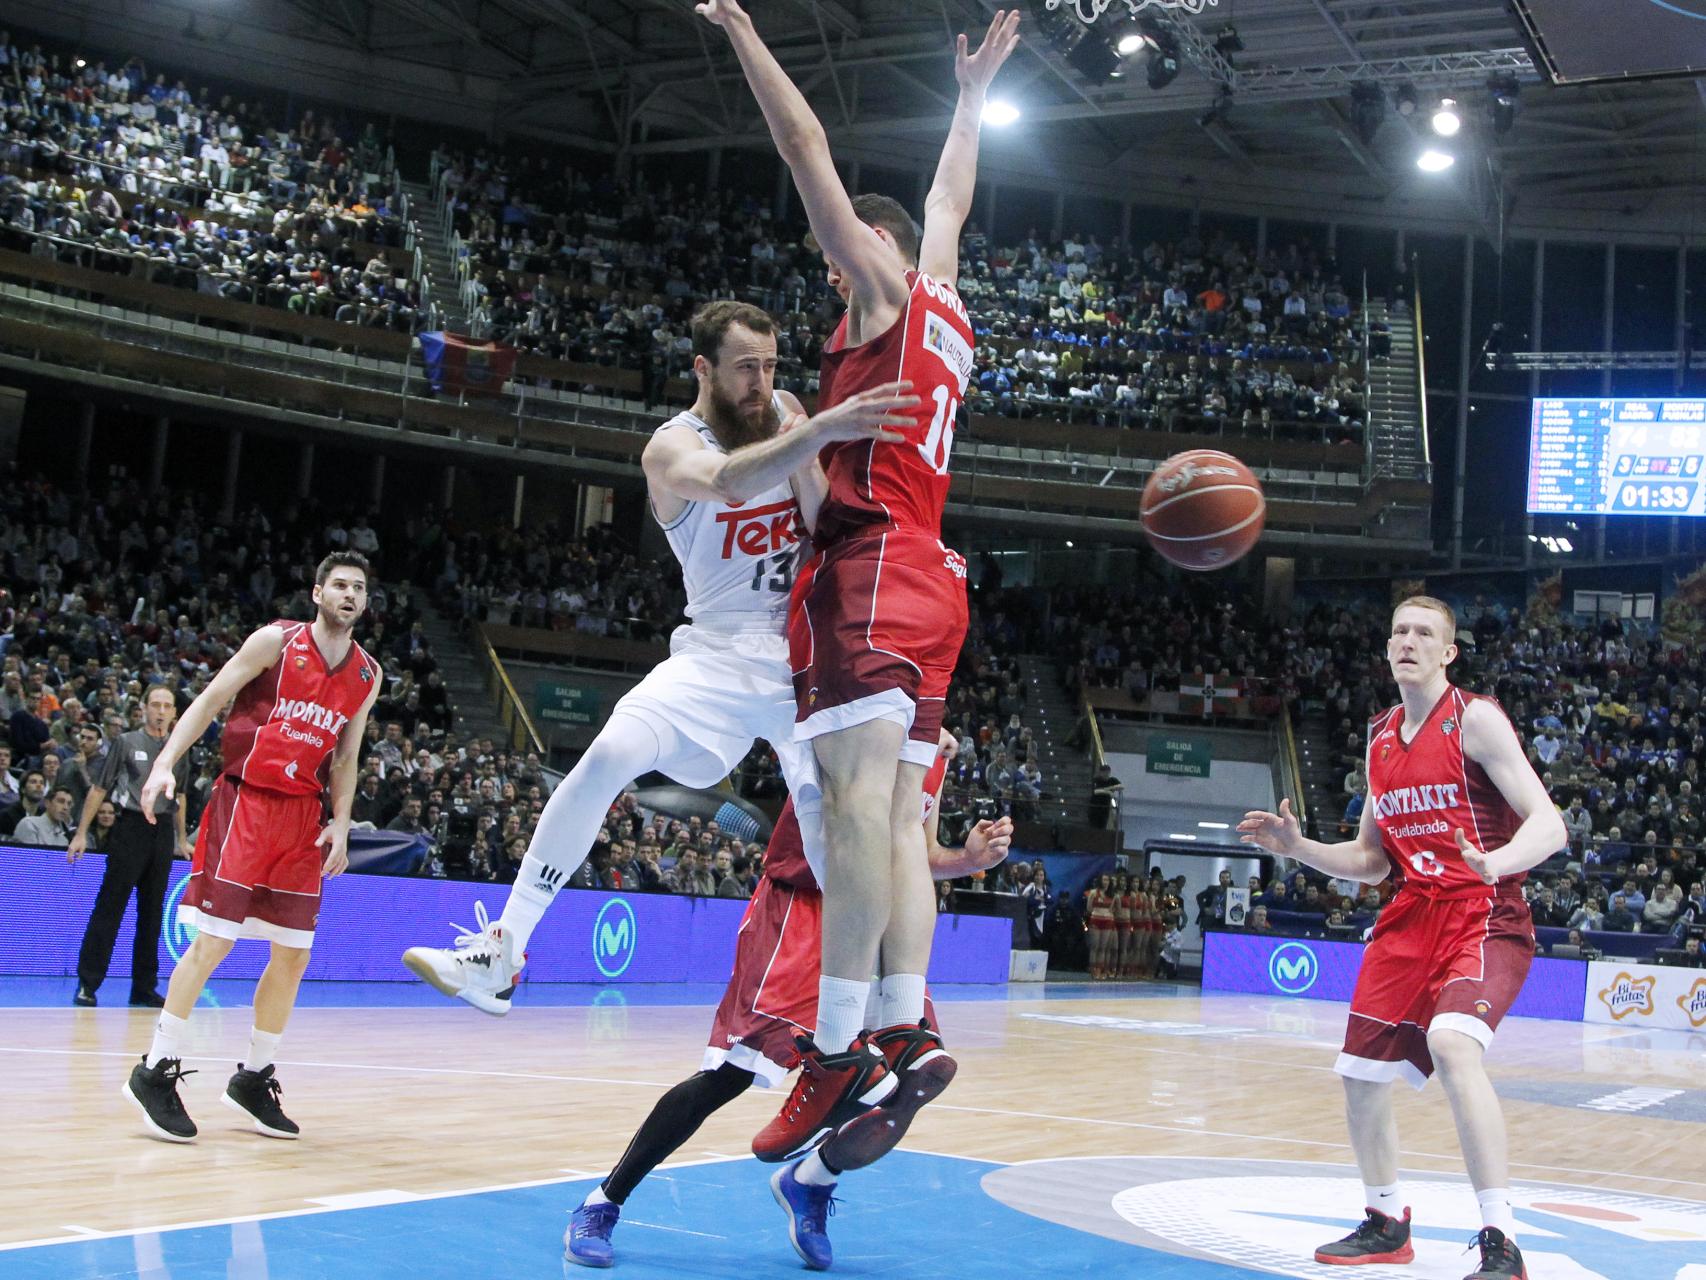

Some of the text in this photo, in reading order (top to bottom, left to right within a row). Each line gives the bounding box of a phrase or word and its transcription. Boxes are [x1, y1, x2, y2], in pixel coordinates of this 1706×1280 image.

[1618, 456, 1631, 473] 3
[1621, 484, 1688, 508] 01:33
[751, 552, 796, 593] 13
[1166, 741, 1192, 752] SALIDA
[1173, 753, 1184, 761] DE
[1154, 762, 1201, 775] EMERGENCIA
[1618, 983, 1629, 995] Bi
[1612, 991, 1645, 1006] frutas
